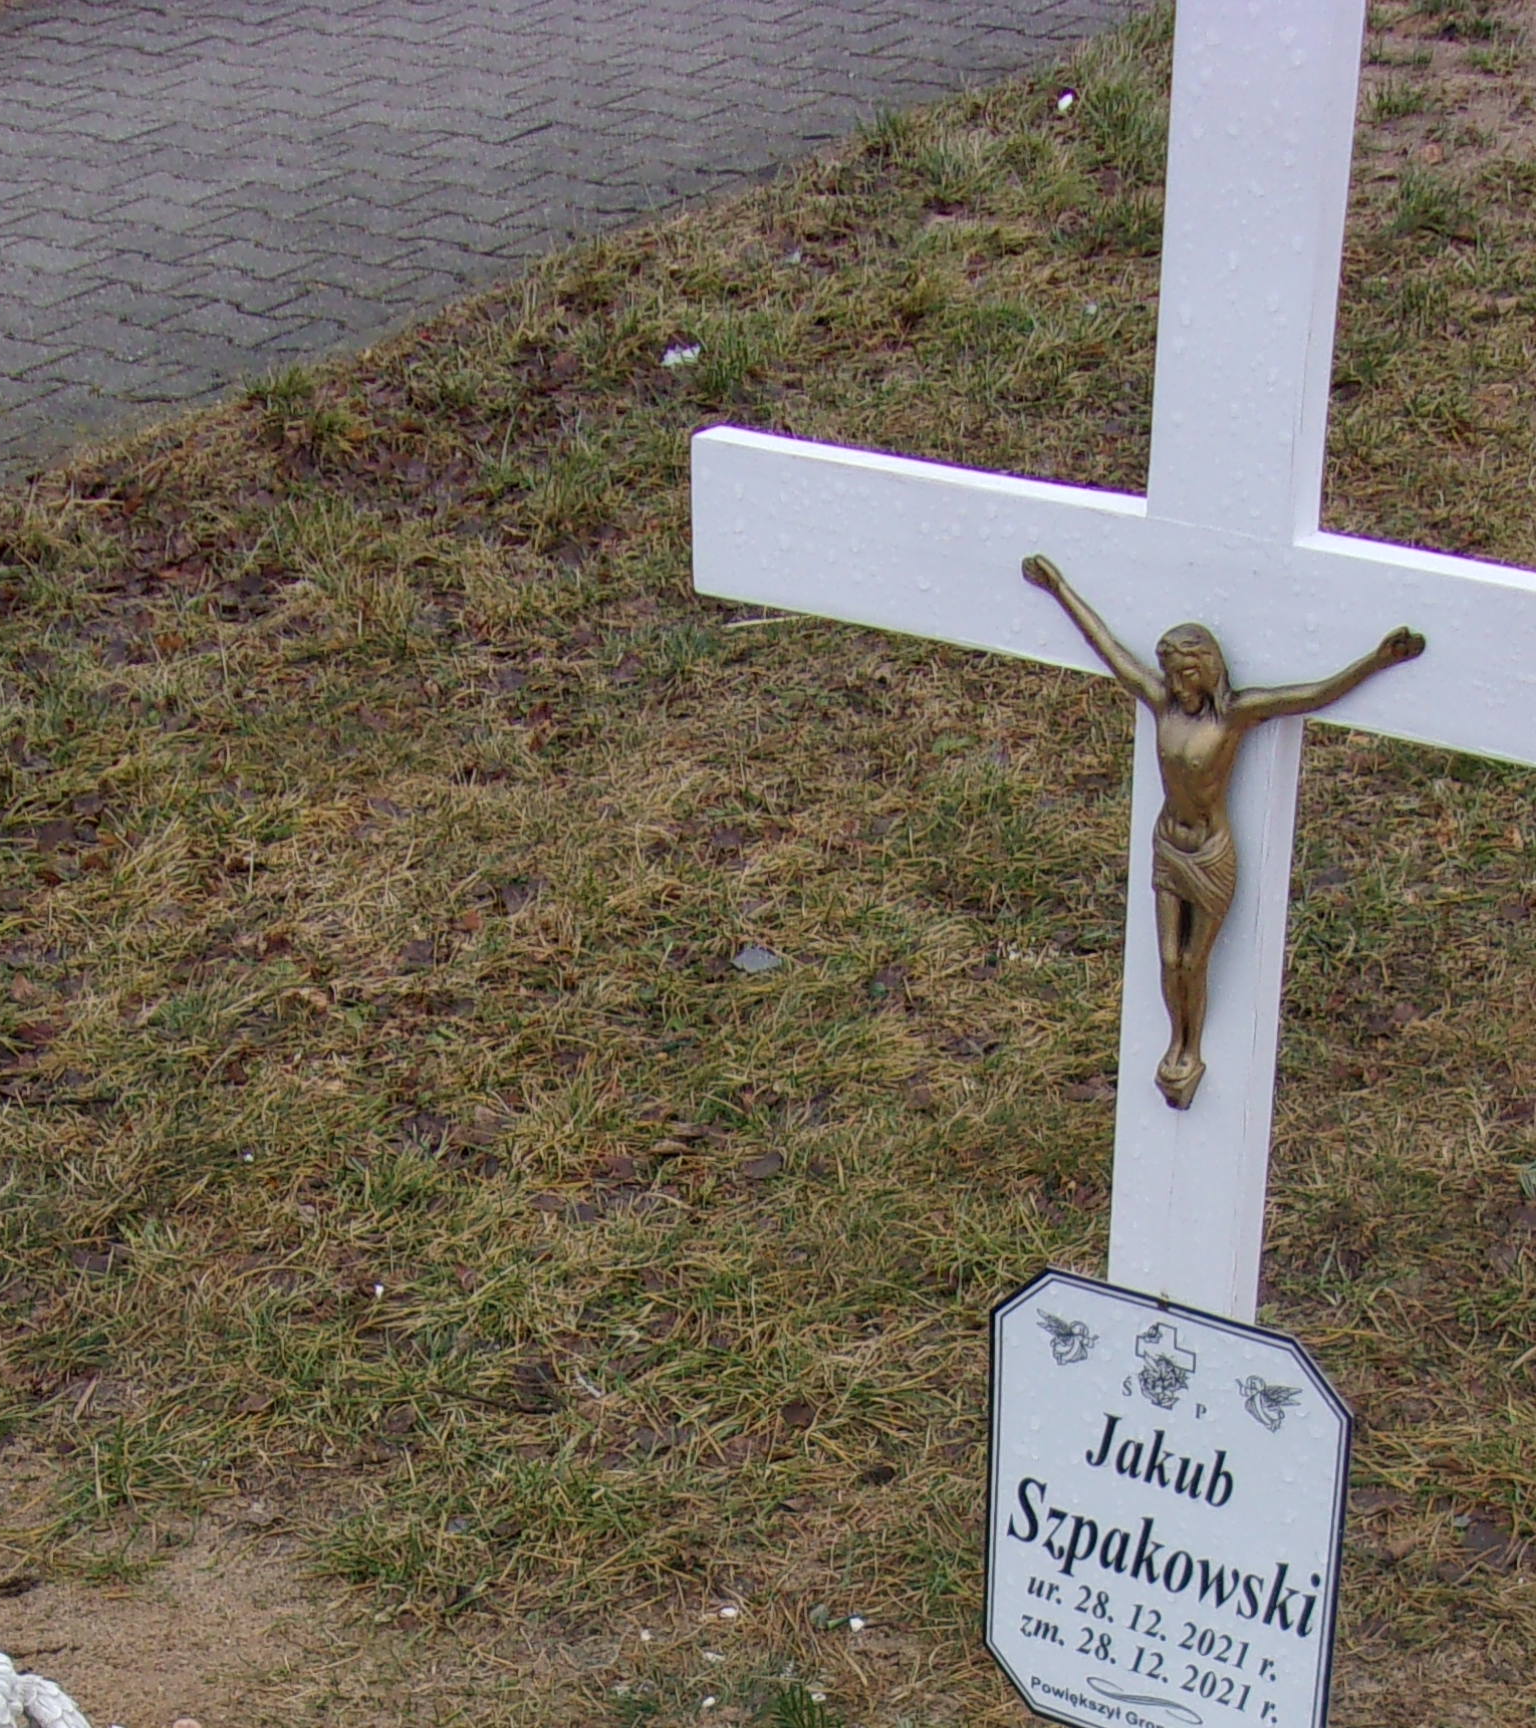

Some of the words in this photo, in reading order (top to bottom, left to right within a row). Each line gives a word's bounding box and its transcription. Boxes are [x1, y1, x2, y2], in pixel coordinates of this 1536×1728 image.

[1122, 1376, 1133, 1397] Ś
[1195, 1403, 1207, 1419] P
[1085, 1412, 1234, 1508] Jakub
[1007, 1477, 1322, 1638] Szpakowski
[1020, 1613, 1065, 1647] zm.
[1076, 1626, 1117, 1665] 28.
[1128, 1645, 1169, 1684] 12.
[1180, 1663, 1252, 1713] 2021
[1260, 1699, 1278, 1725] r.
[1026, 1575, 1062, 1606] ur.
[1074, 1584, 1115, 1624] 28.
[1126, 1603, 1167, 1642] 12.
[1178, 1621, 1251, 1670] 2021
[1258, 1656, 1277, 1682] r.
[1030, 1675, 1122, 1720] Powiększył
